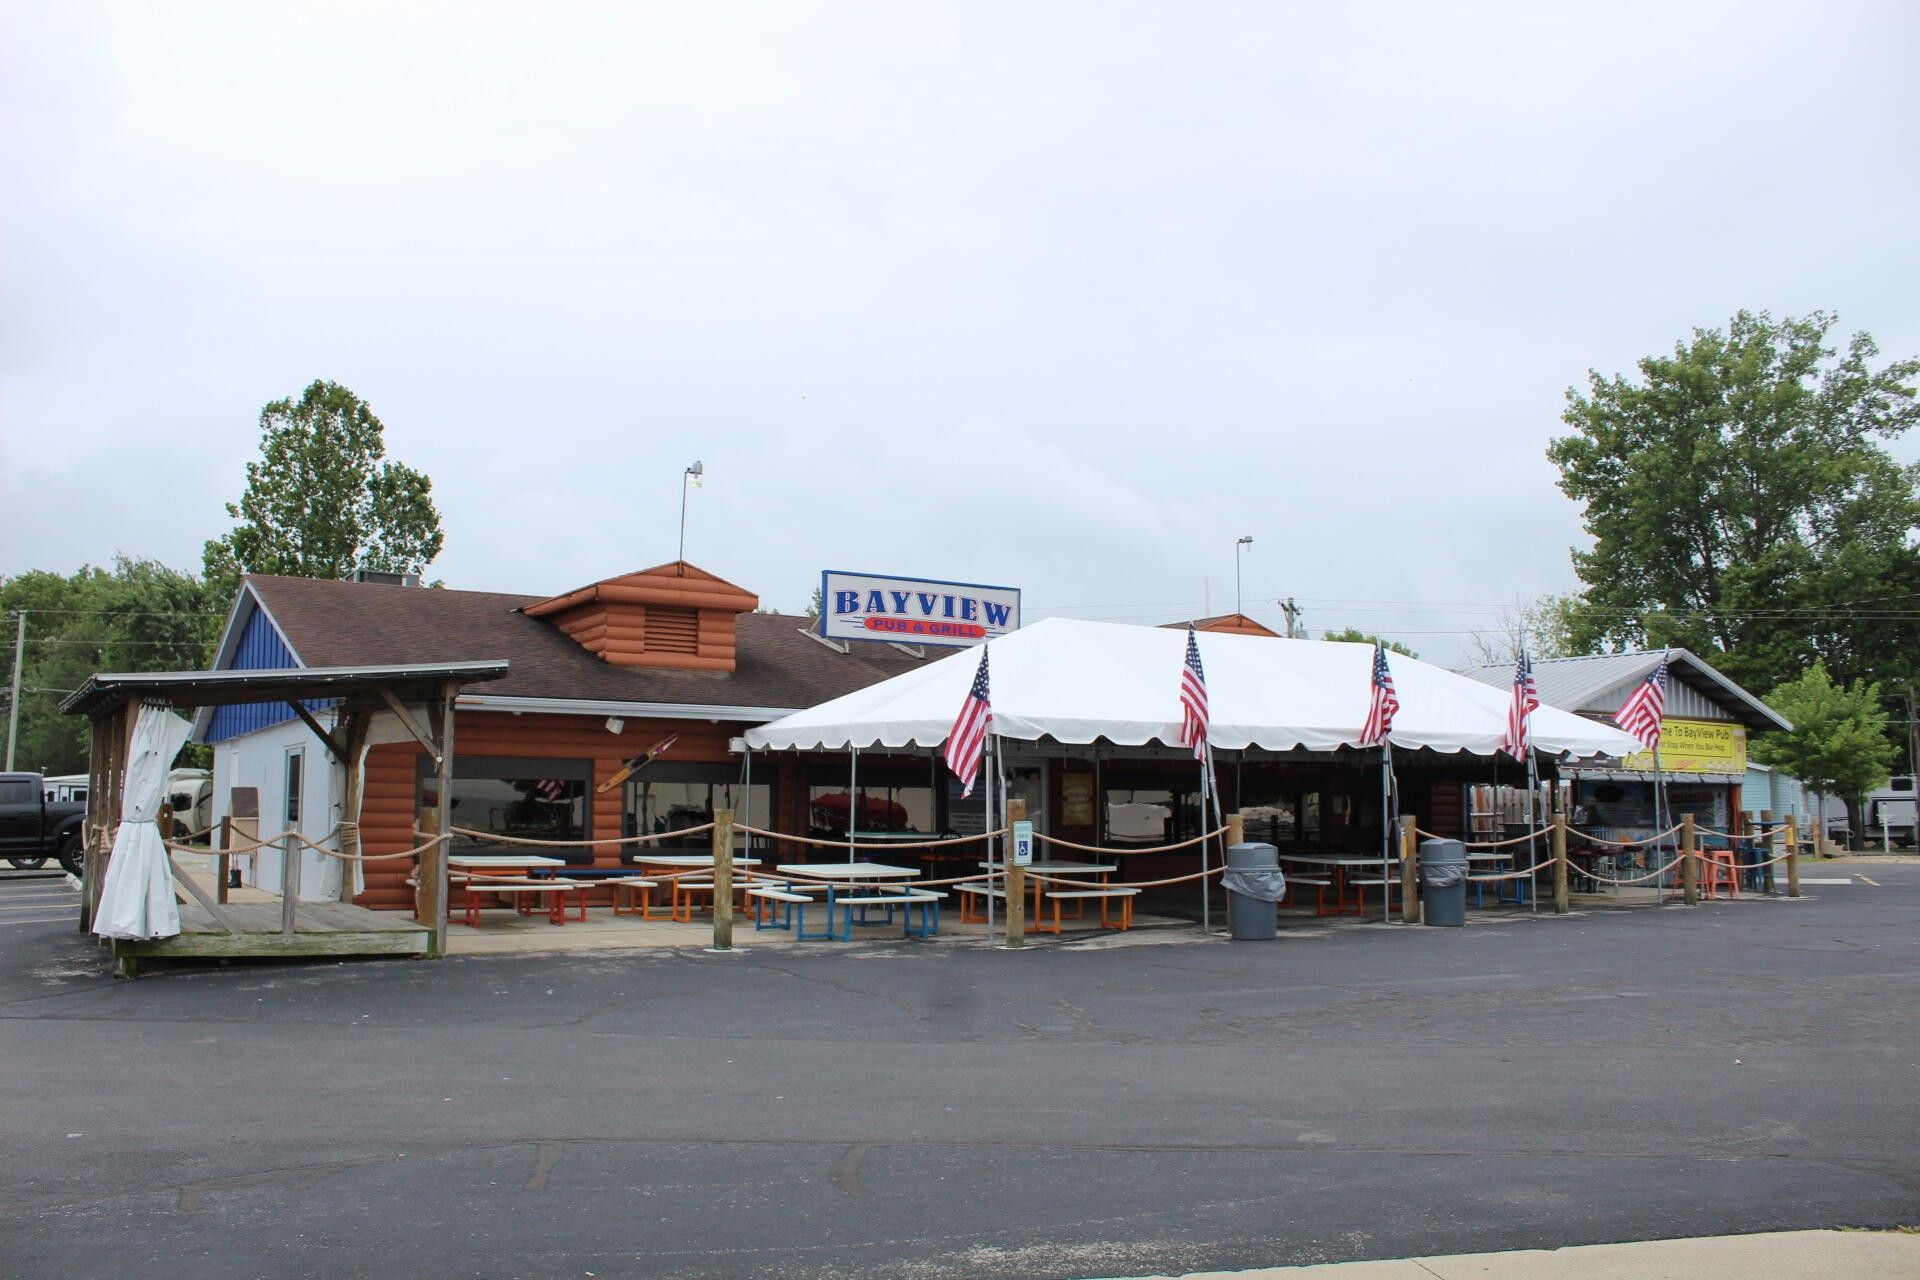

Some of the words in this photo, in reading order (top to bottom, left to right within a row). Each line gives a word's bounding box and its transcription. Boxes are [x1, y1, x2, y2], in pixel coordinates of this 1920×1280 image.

[834, 590, 1012, 627] BAYVIEW
[873, 619, 907, 632] PUB
[913, 621, 923, 632] &
[929, 623, 977, 637] GRILL
[1674, 726, 1683, 737] To
[1684, 727, 1714, 740] BayView
[1716, 729, 1730, 740] Pub
